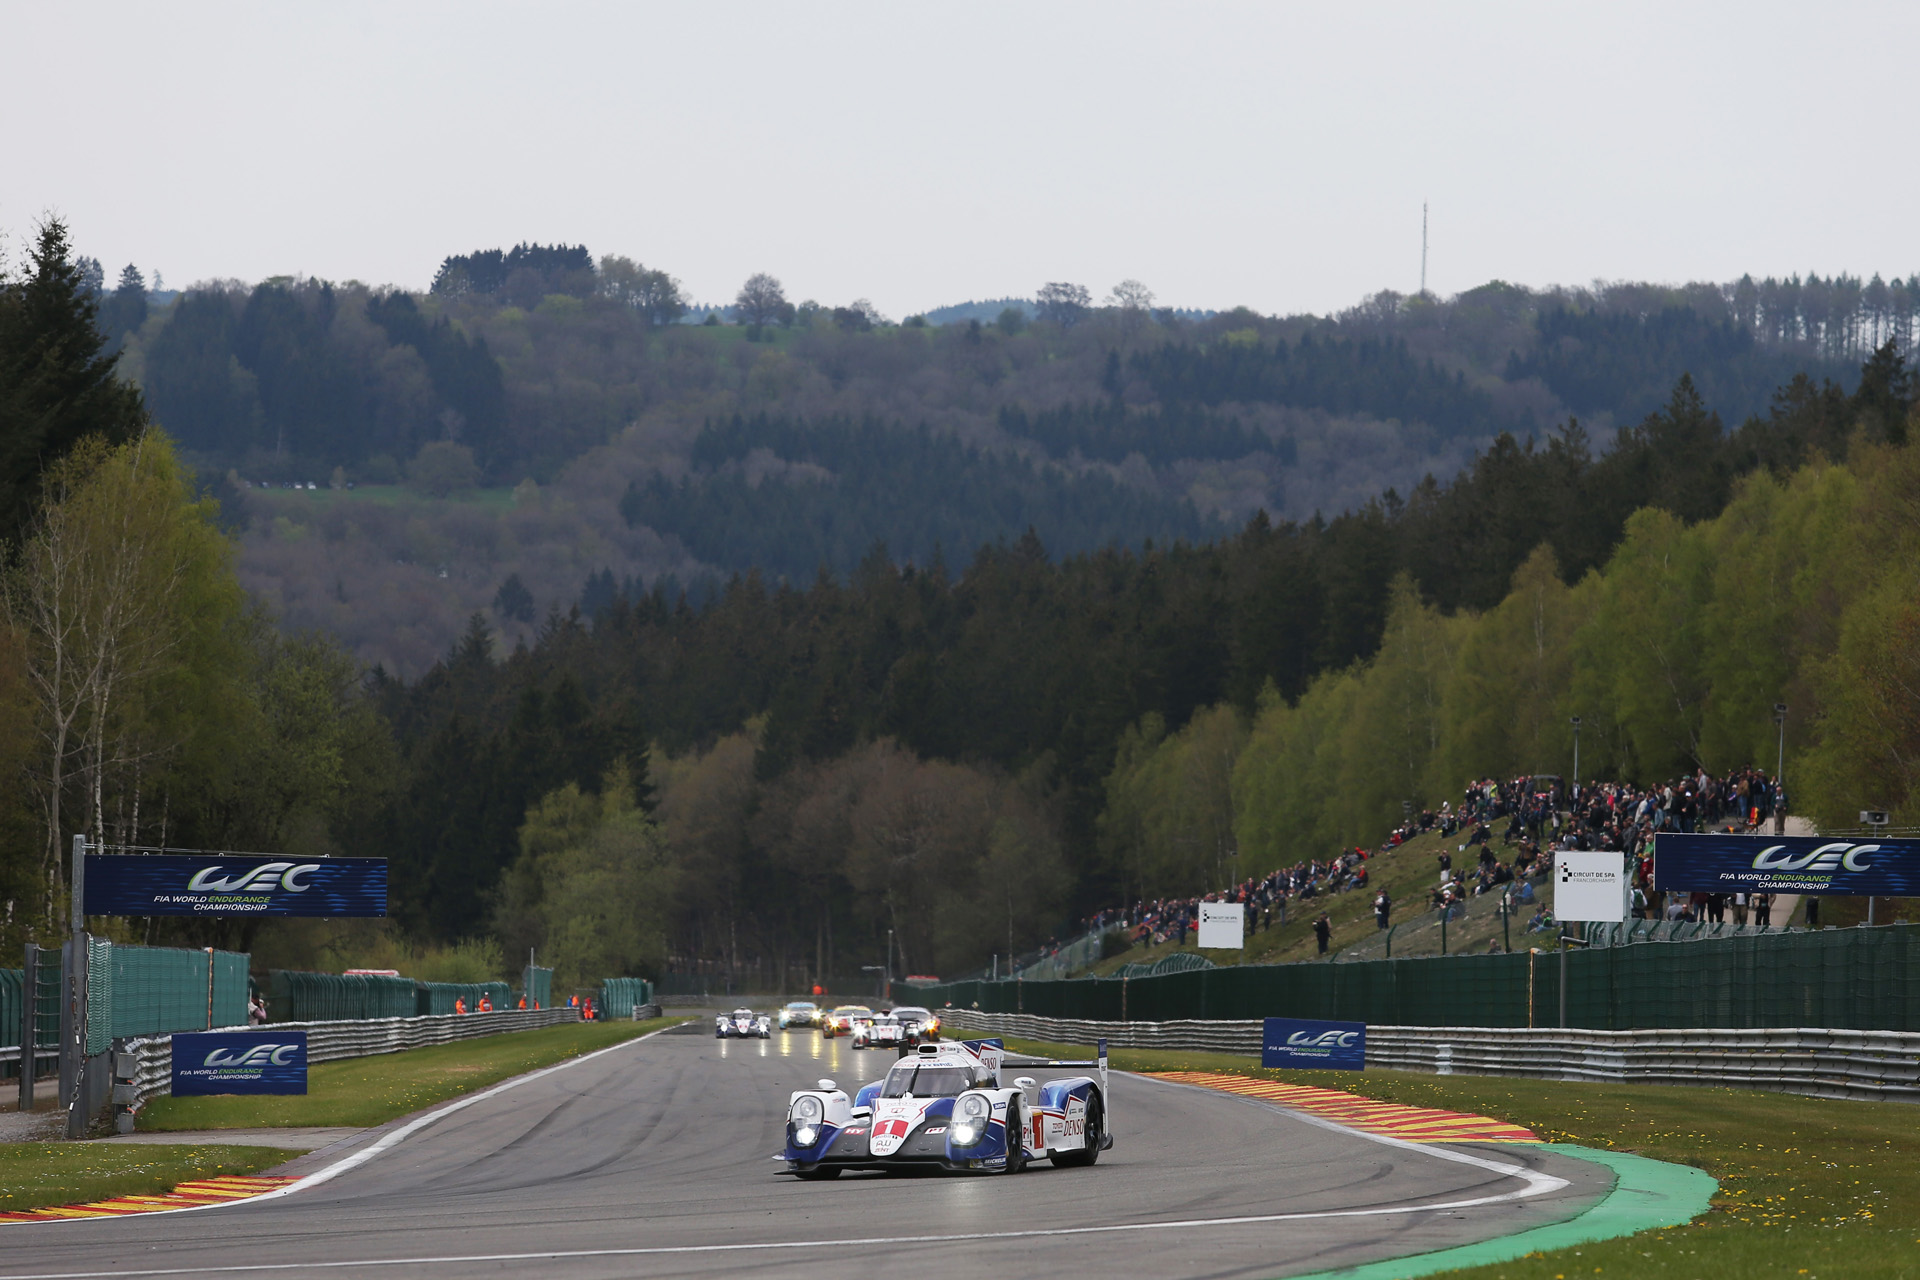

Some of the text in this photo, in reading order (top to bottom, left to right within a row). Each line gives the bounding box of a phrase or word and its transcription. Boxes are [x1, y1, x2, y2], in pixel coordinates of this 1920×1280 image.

[1752, 842, 1881, 872] WEC
[187, 862, 321, 892] WEC
[1758, 881, 1829, 890] CHAMPIONSHIP
[1771, 874, 1832, 882] ENDURANCE
[153, 895, 271, 904] FIA WORLD ENDURANCE
[1286, 1030, 1360, 1048] WEC
[203, 1044, 299, 1067] WEC
[884, 1119, 896, 1135] 1
[1063, 1118, 1085, 1137] DENSO
